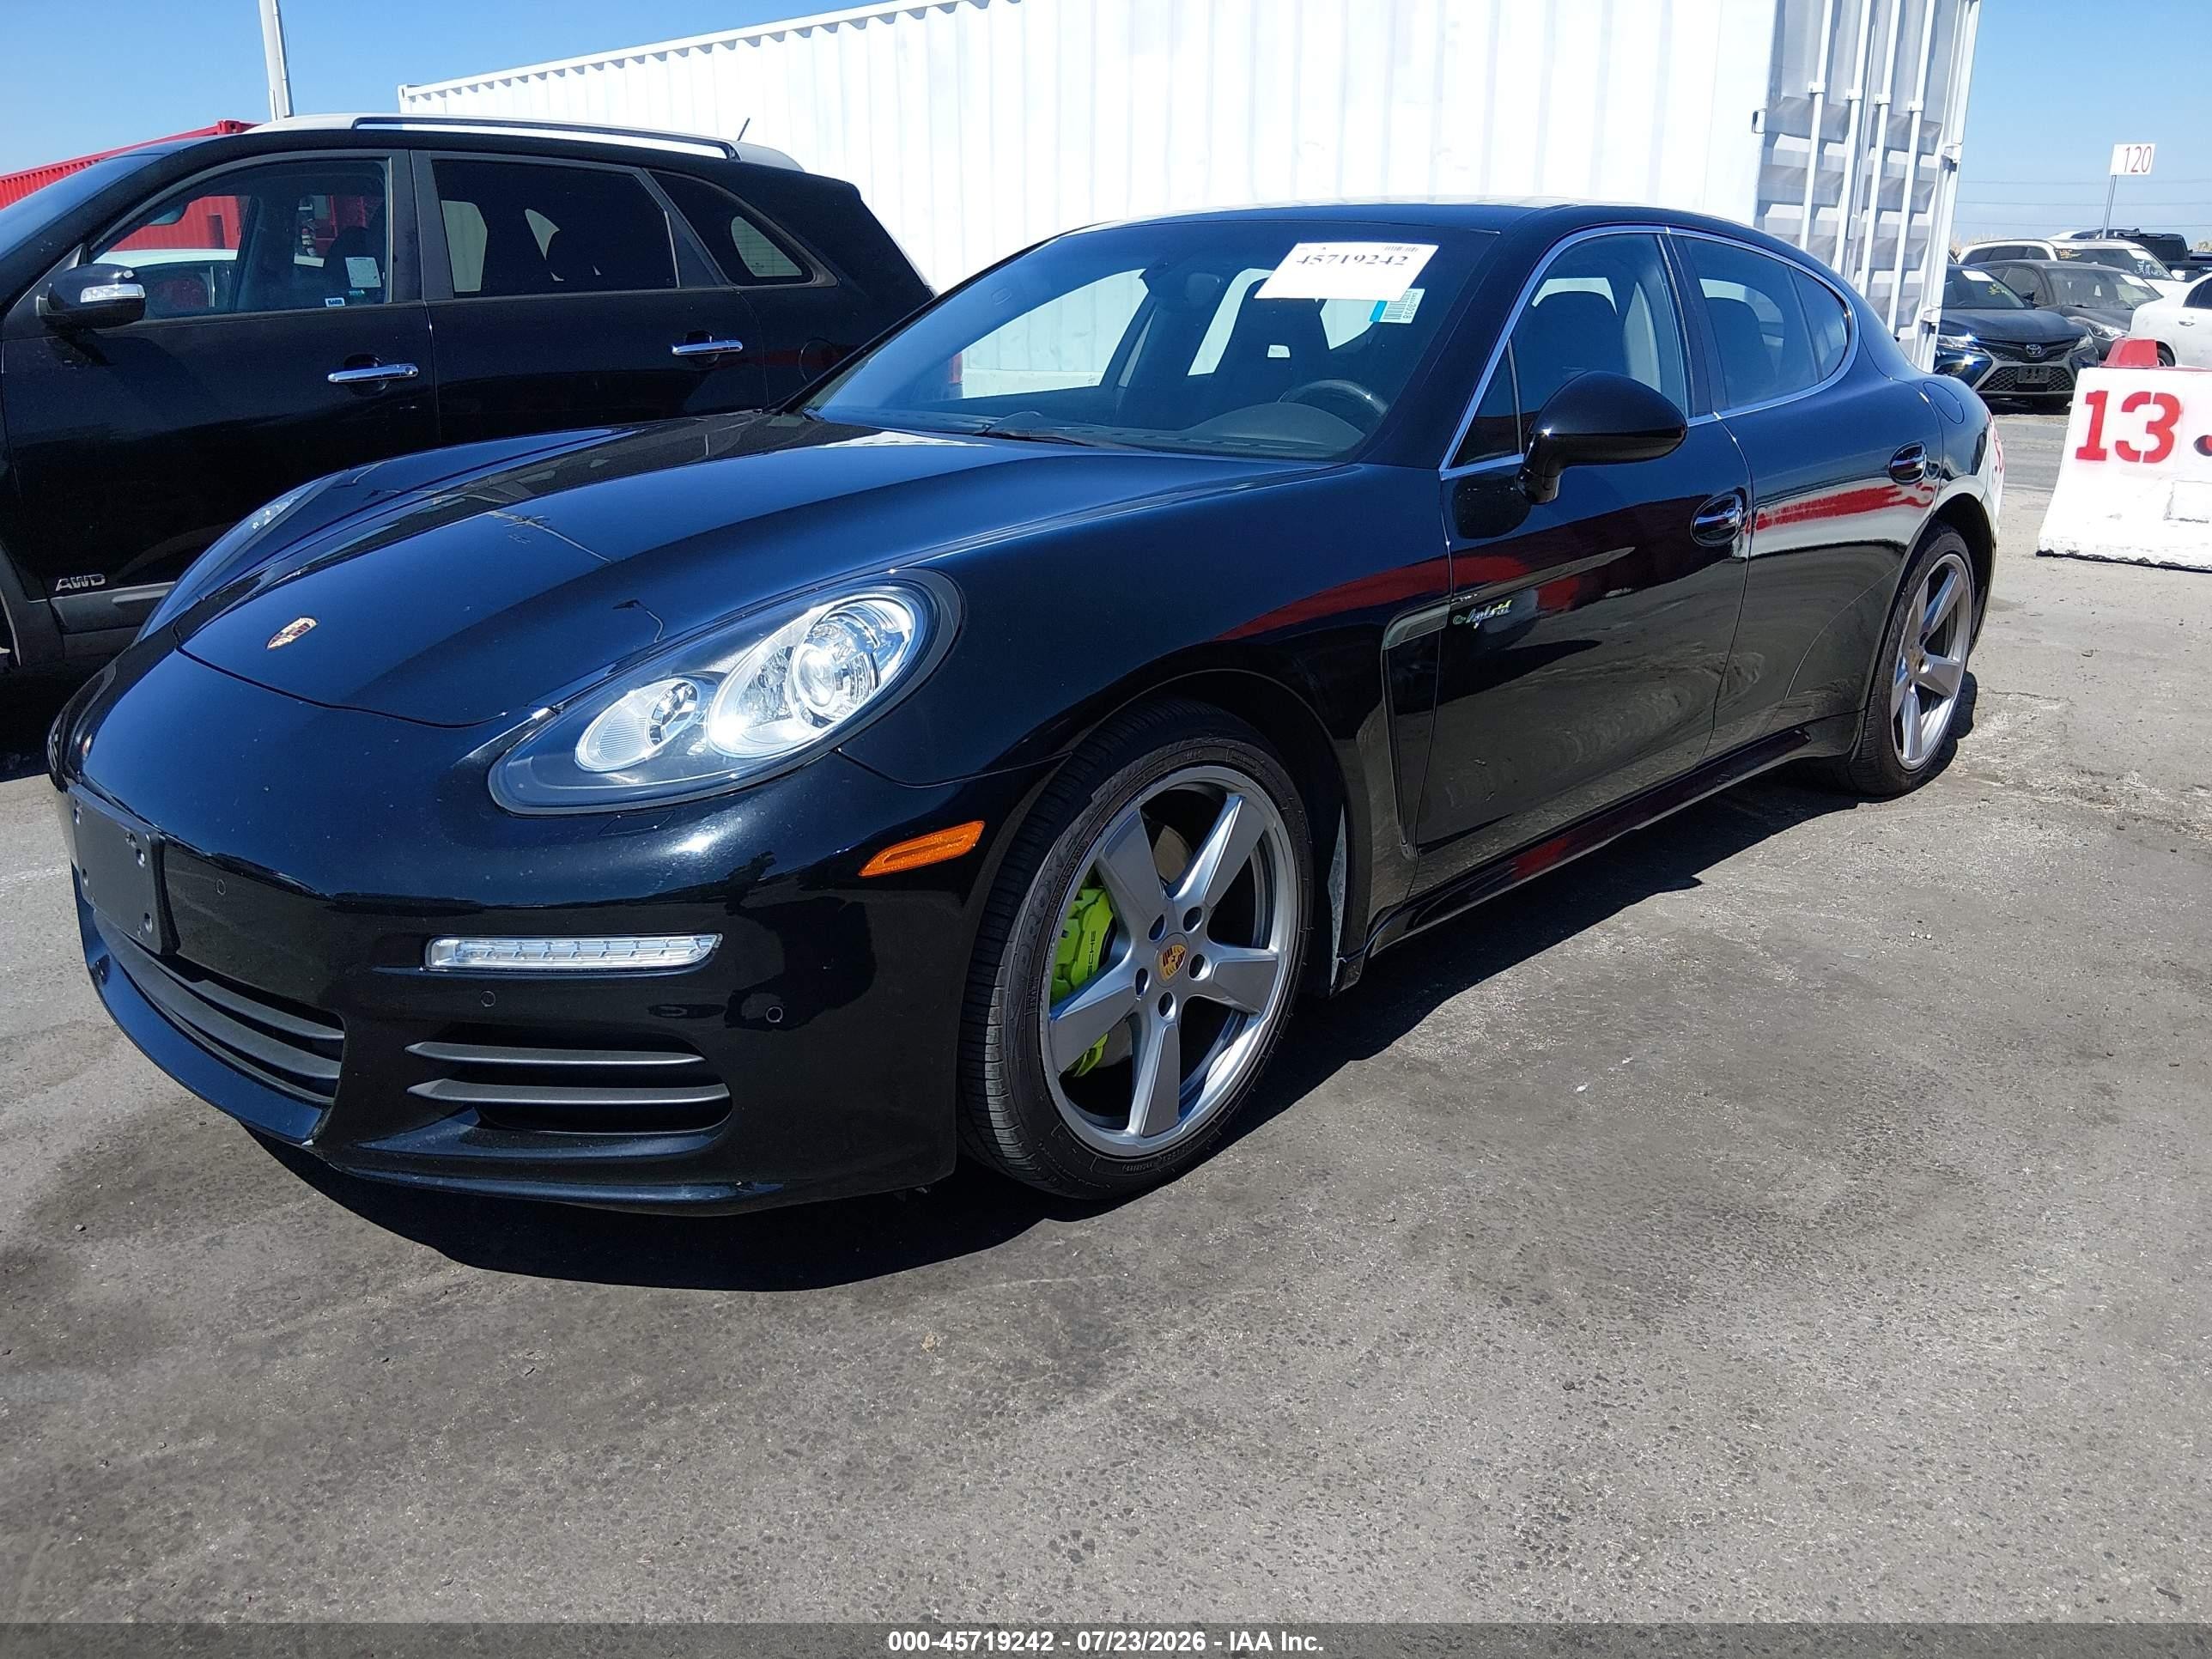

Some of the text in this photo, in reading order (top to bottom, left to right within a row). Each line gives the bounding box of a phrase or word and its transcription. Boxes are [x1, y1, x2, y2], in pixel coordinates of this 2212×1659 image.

[2124, 145, 2153, 173] 120
[1297, 254, 1409, 266] 45719242
[2075, 389, 2182, 464] 13
[55, 574, 106, 592] AWD
[1086, 930, 1097, 979] SCHE
